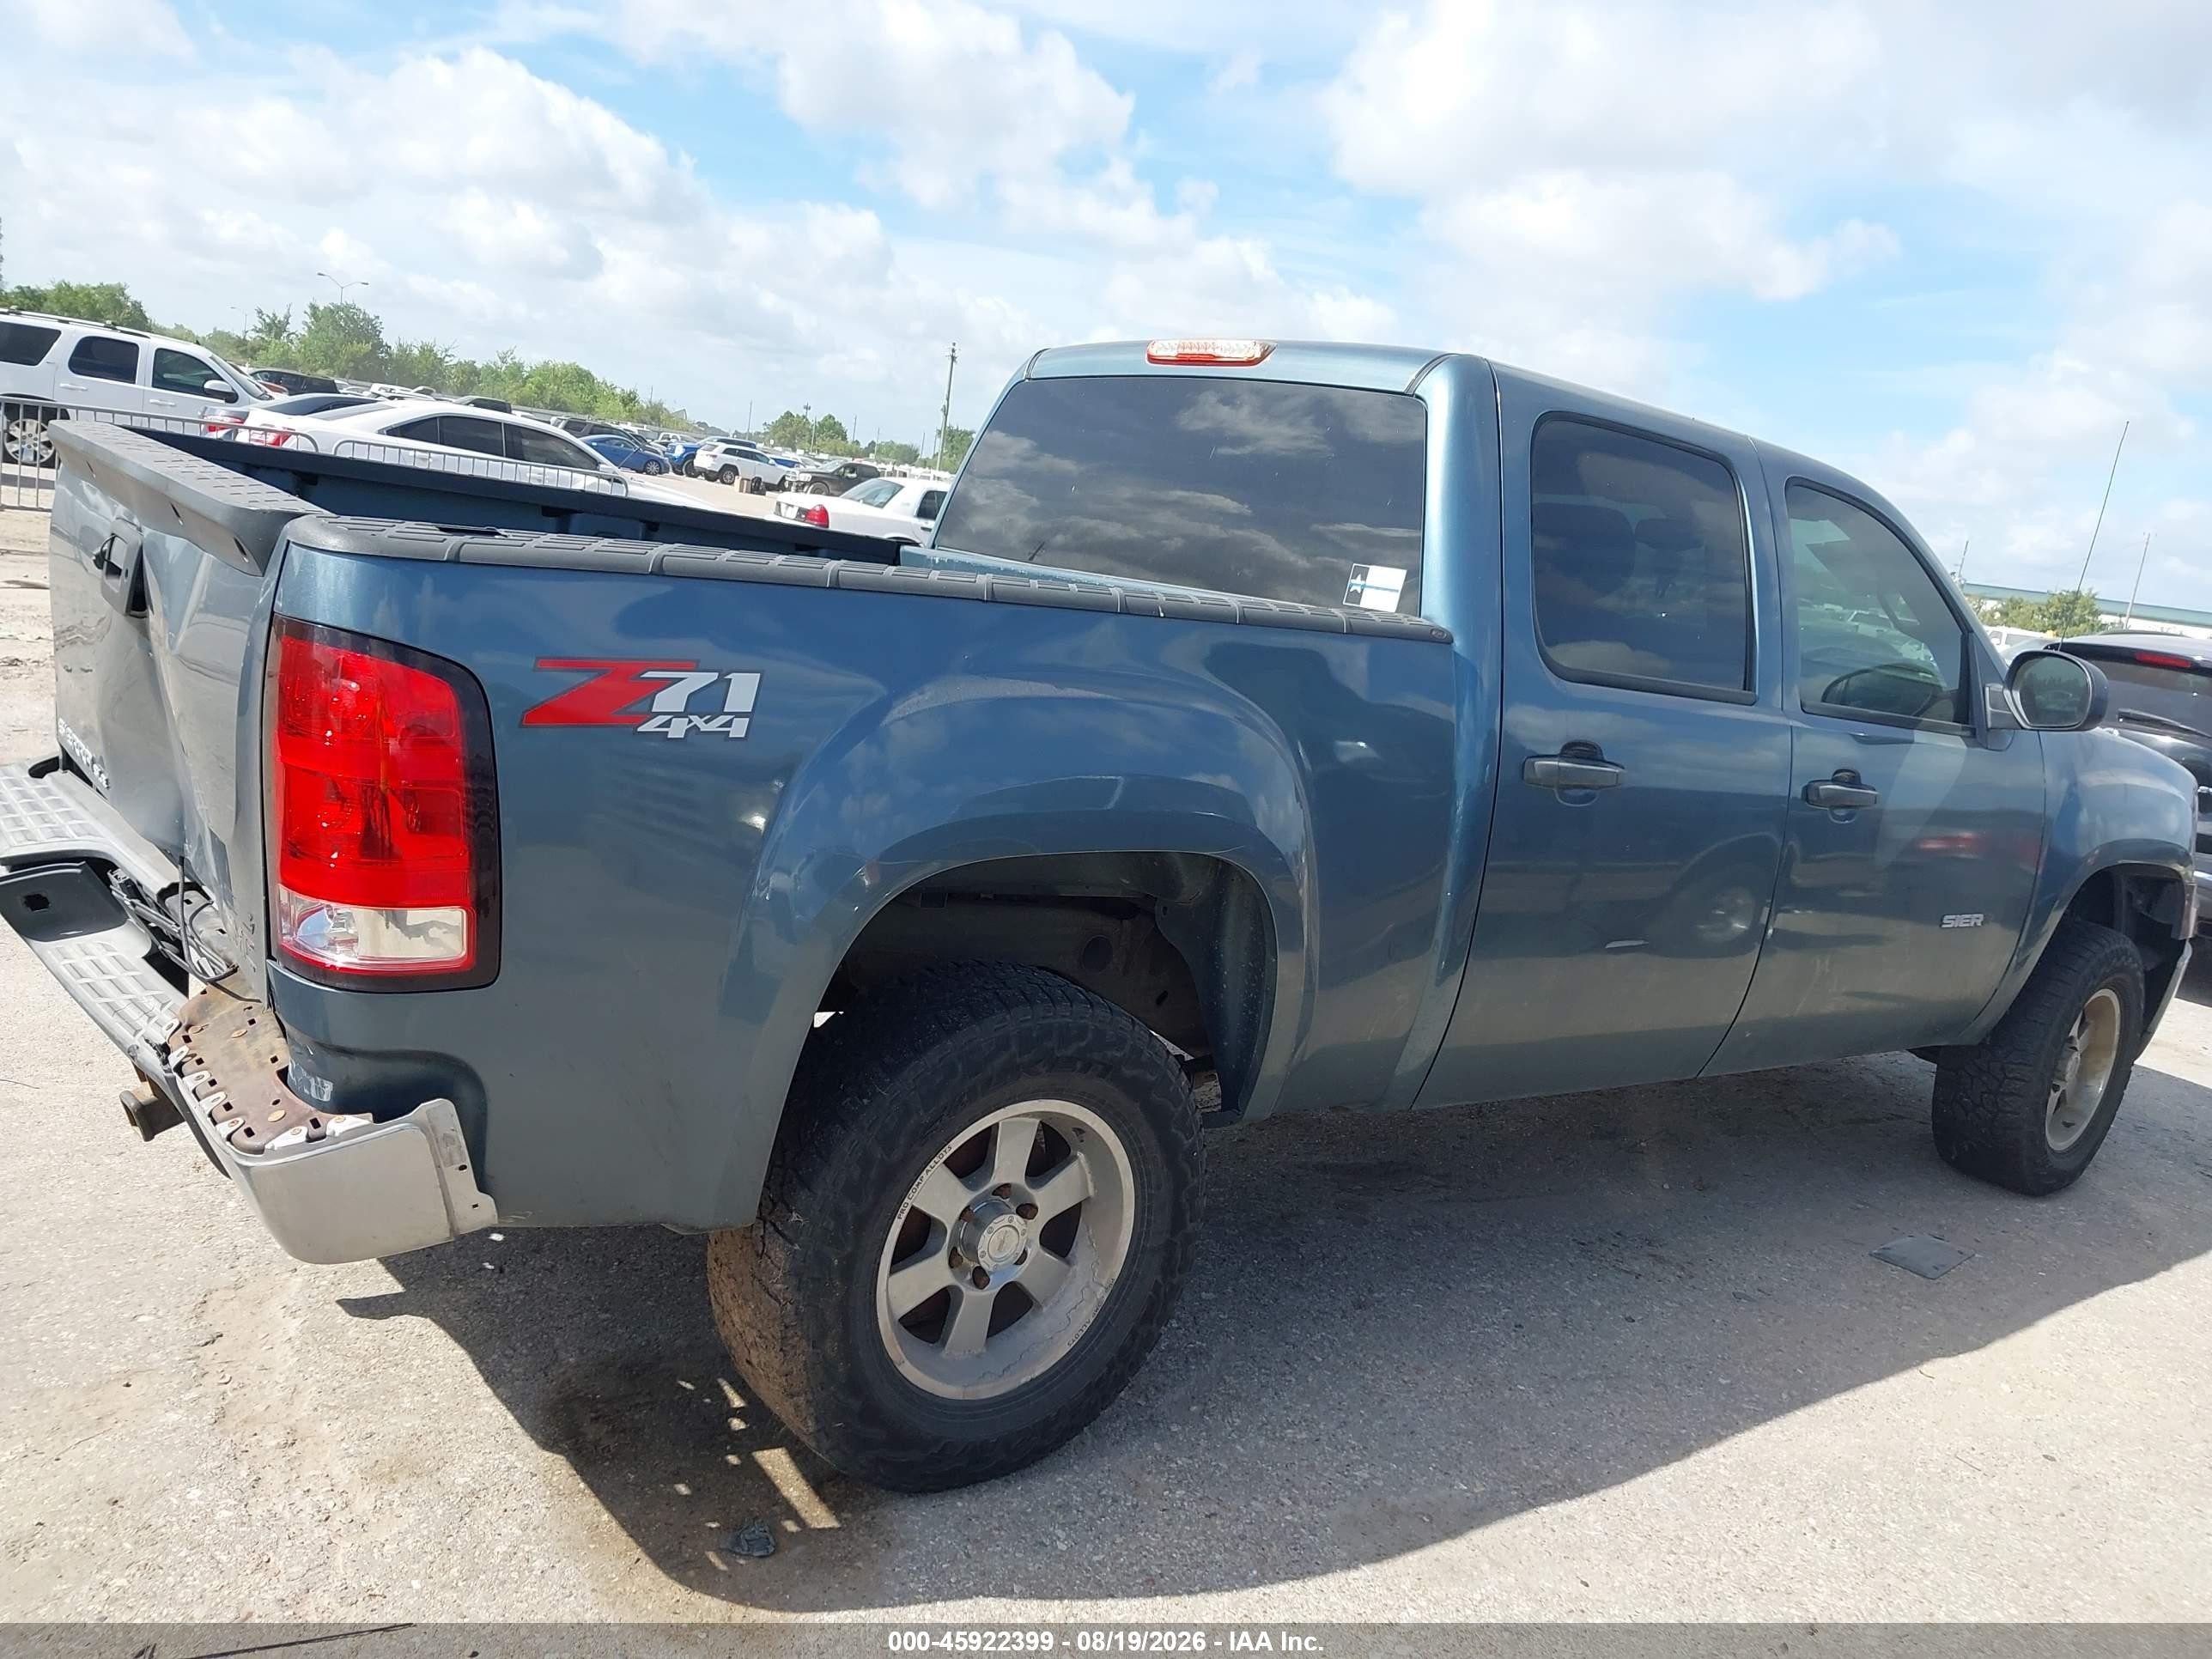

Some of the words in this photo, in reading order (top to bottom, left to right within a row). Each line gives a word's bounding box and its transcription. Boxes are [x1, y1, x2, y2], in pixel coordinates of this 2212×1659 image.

[521, 658, 763, 726] Z71
[1941, 913, 1985, 929] SIER
[896, 1201, 909, 1220] PRO
[907, 1176, 925, 1200] COMP
[925, 1145, 953, 1176] ALLOYS
